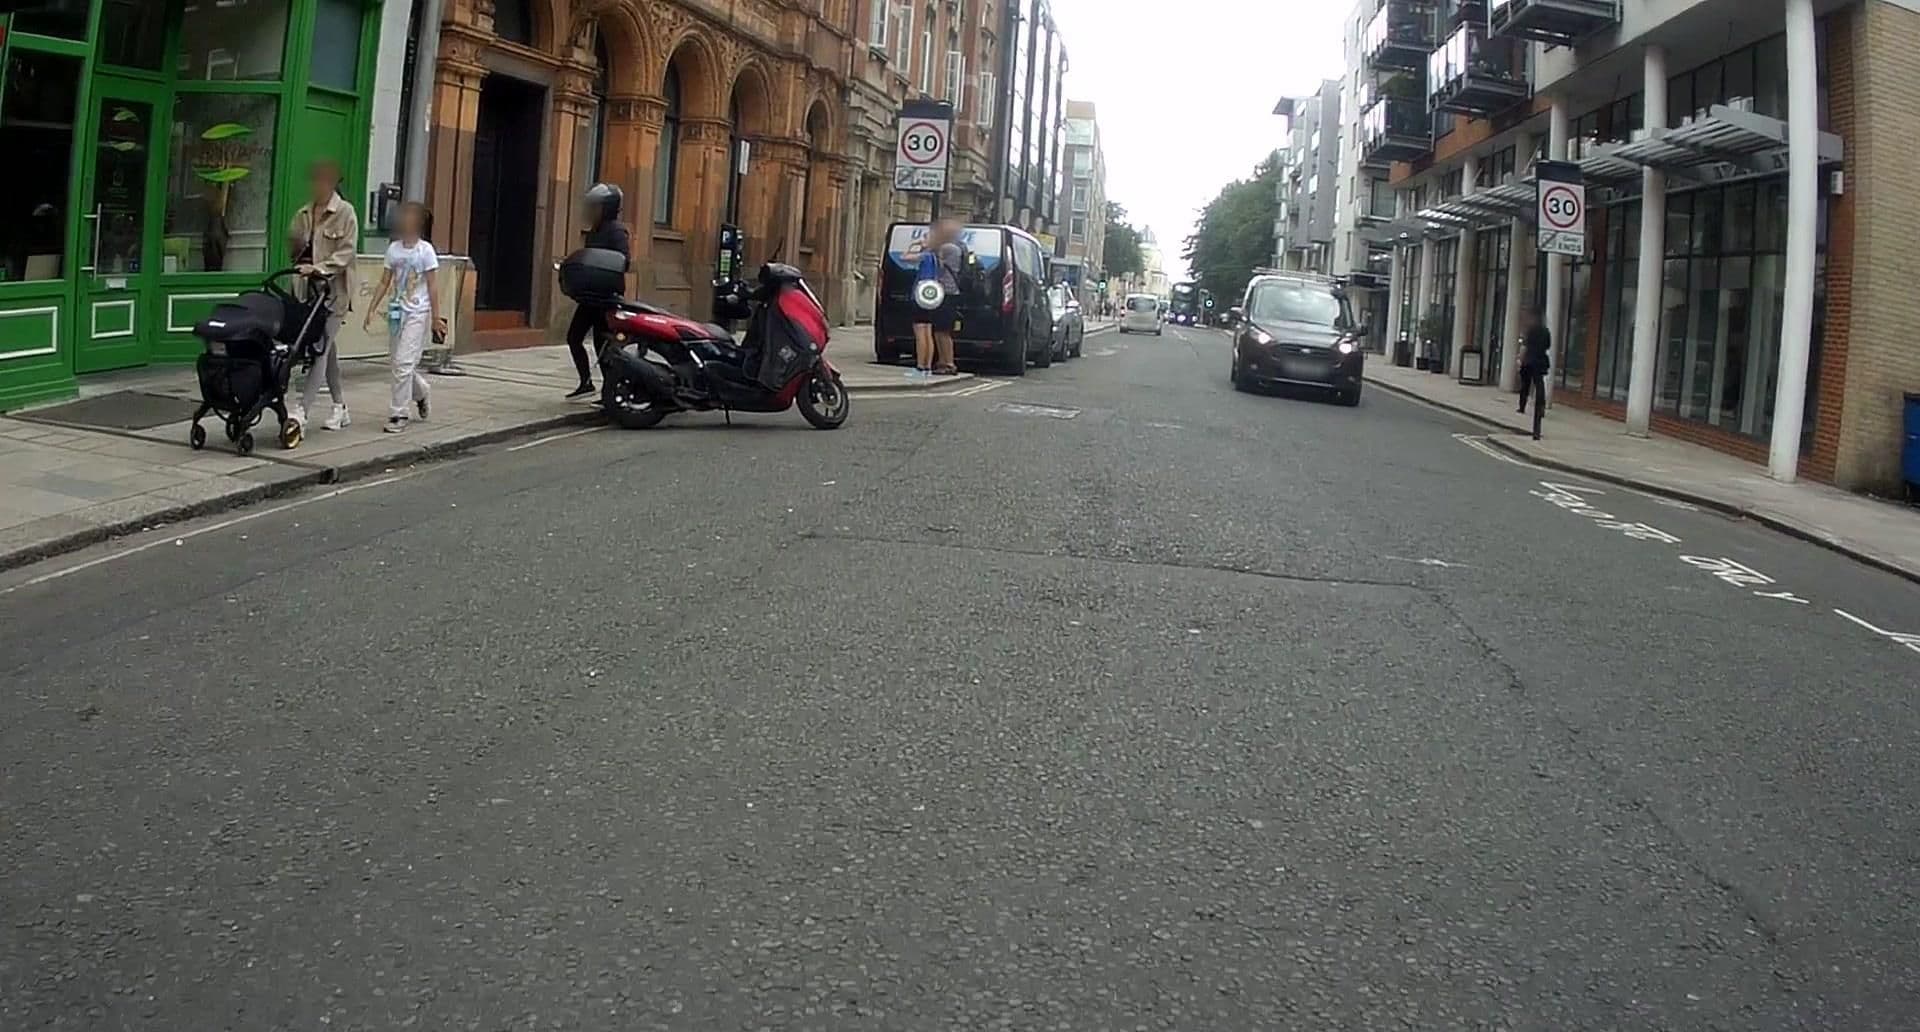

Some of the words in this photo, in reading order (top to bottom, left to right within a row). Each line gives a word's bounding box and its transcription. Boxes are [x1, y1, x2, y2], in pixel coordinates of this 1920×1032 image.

[908, 134, 938, 152] 30
[915, 178, 942, 187] ENDS
[1549, 197, 1576, 216] 30
